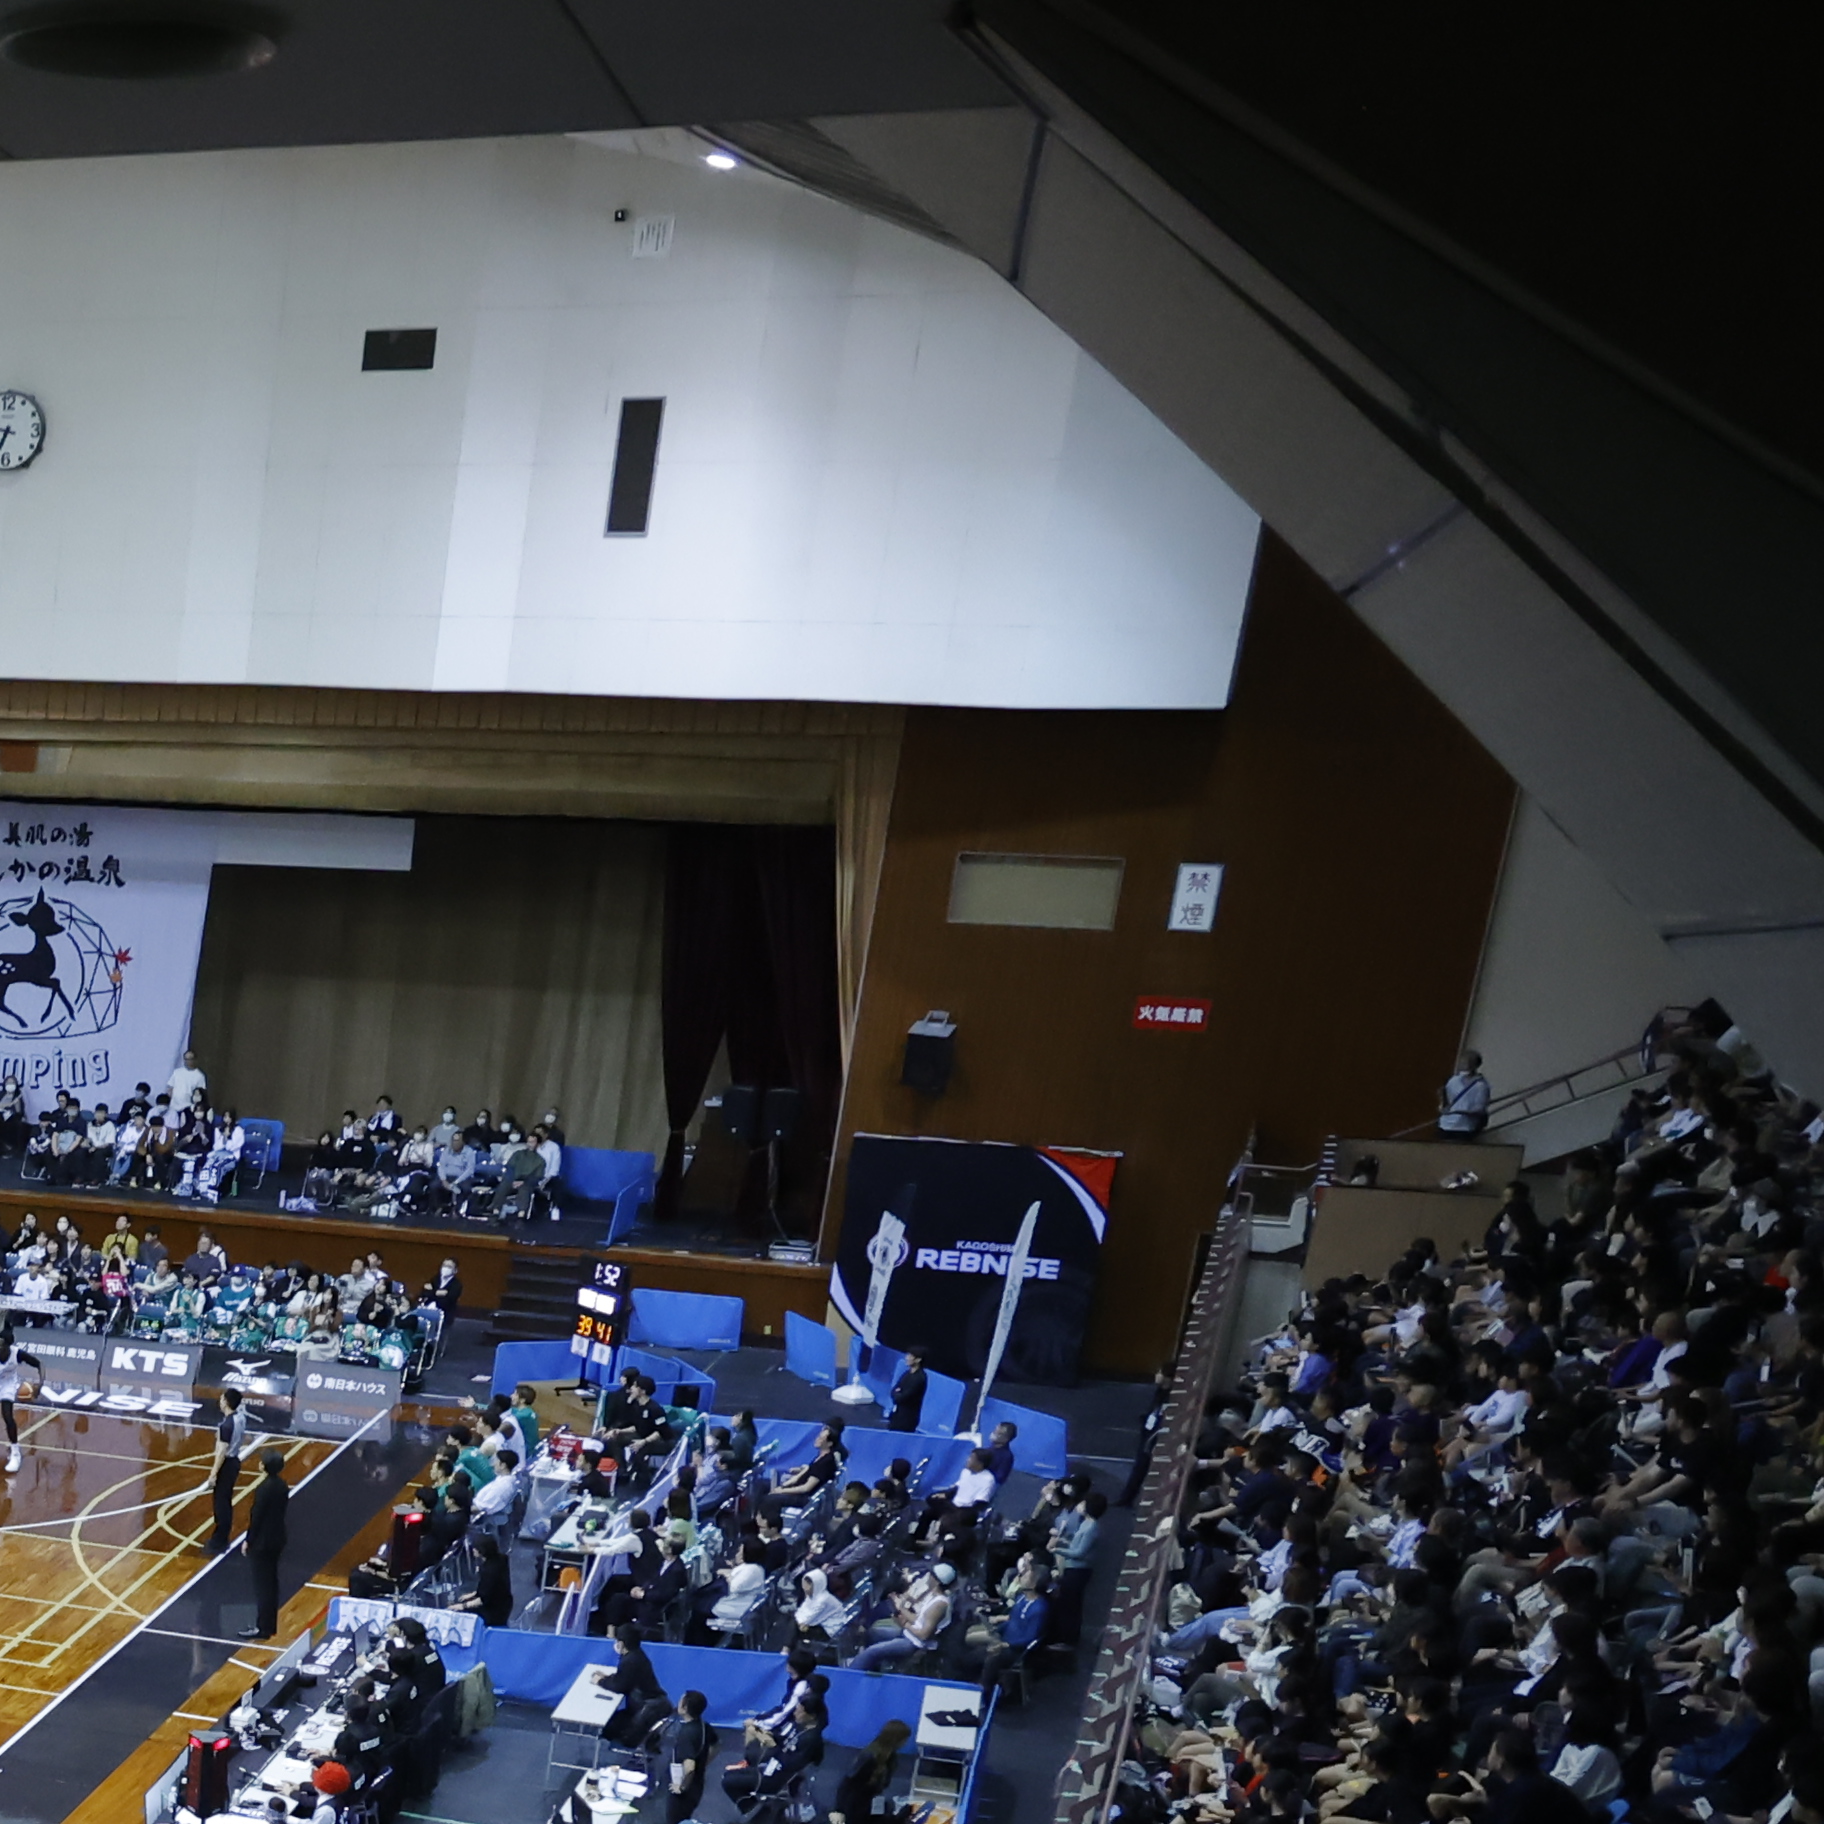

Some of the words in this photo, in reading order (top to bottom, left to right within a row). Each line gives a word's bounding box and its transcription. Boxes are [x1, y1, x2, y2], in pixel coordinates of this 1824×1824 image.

[2, 395, 16, 411] 12
[31, 423, 41, 438] 3
[1, 452, 11, 467] 6
[3, 821, 93, 848] 美肌の湯
[1179, 870, 1212, 926] 禁煙
[956, 1240, 1016, 1254] KAGOSHIM
[915, 1248, 1061, 1280] REBNSE
[111, 1347, 190, 1376] KTS
[324, 1376, 386, 1396] 南日本ハウス
